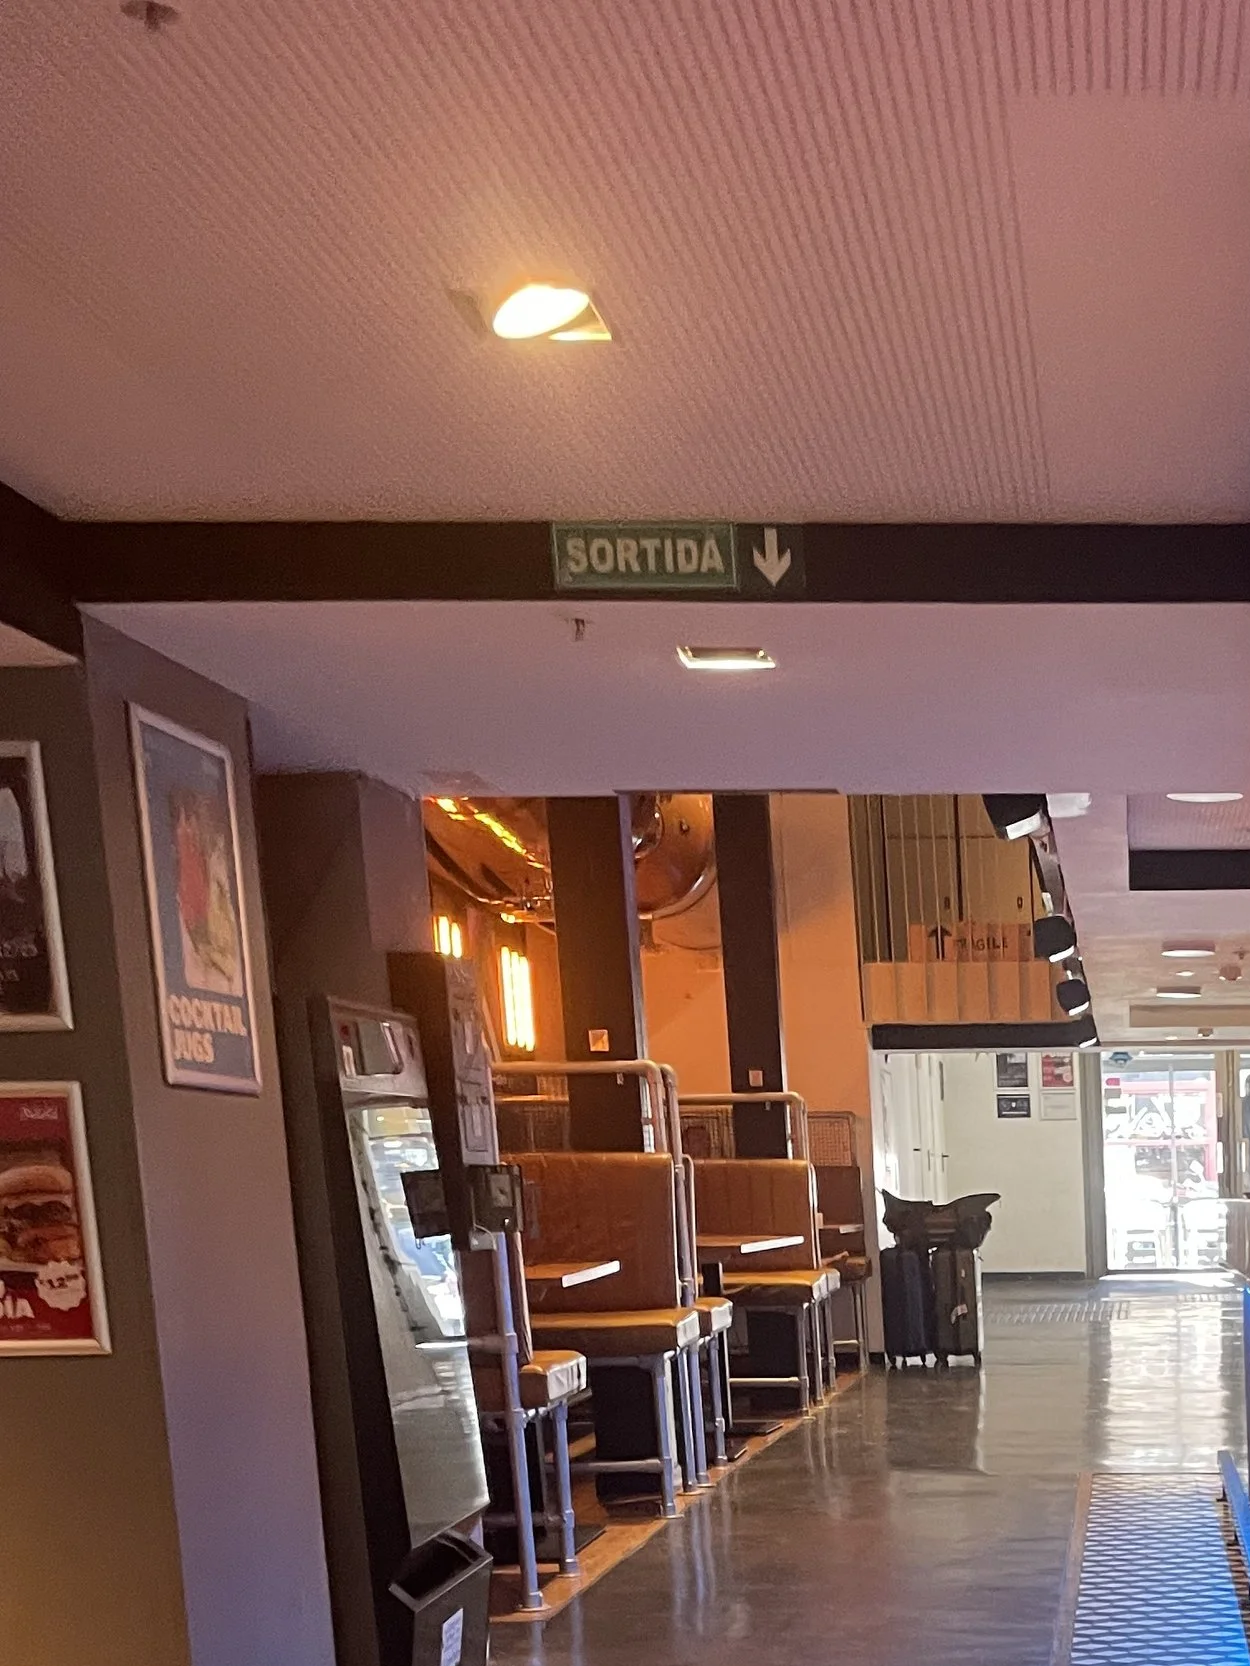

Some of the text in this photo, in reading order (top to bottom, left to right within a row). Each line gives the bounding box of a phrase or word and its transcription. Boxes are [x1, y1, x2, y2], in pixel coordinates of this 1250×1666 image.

[566, 537, 725, 574] SORTIDA
[167, 994, 247, 1036] COCKTAIL
[173, 1028, 215, 1063] JUGS
